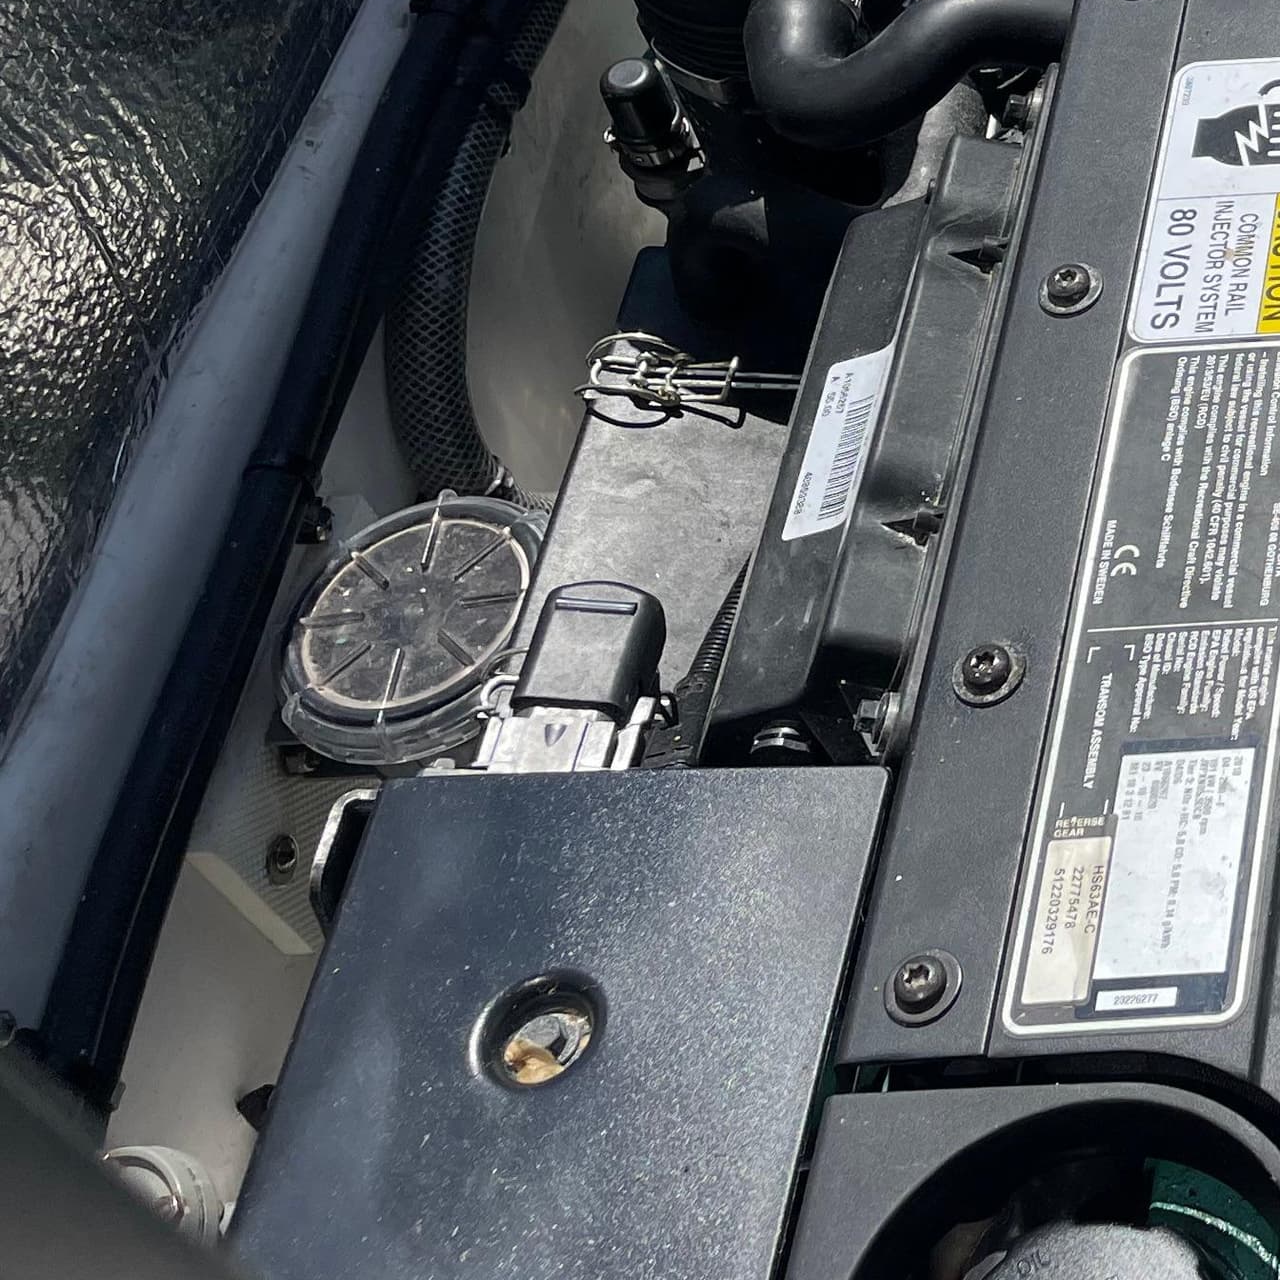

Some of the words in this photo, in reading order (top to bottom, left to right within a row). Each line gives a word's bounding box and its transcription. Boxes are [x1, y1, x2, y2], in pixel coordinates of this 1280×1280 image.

[1165, 208, 1197, 237] 80
[1203, 199, 1233, 270] INJECTOR
[1229, 212, 1259, 280] COMMON
[1149, 244, 1191, 330] VOLTS
[1193, 273, 1222, 333] SYSTEM
[1224, 281, 1248, 316] RAIL
[1266, 390, 1280, 424] Control
[1243, 417, 1259, 469] recreational
[1258, 425, 1275, 476] Information
[1101, 519, 1117, 548] MADE
[1188, 482, 1208, 539] Recreational
[1207, 514, 1219, 535] CFR
[1099, 549, 1111, 560] IN
[1185, 540, 1199, 564] Craft
[1226, 521, 1244, 576] commercial
[1258, 543, 1276, 606] GOTHENBURG
[1091, 560, 1109, 604] SWEDEN
[1178, 566, 1195, 609] Directive
[1092, 672, 1113, 727] TRANSOM
[1081, 728, 1103, 789] ASSEMBLY
[1052, 827, 1084, 838] GEAR
[1039, 867, 1066, 954] 51220329176
[1082, 864, 1105, 934] HS63AE-C
